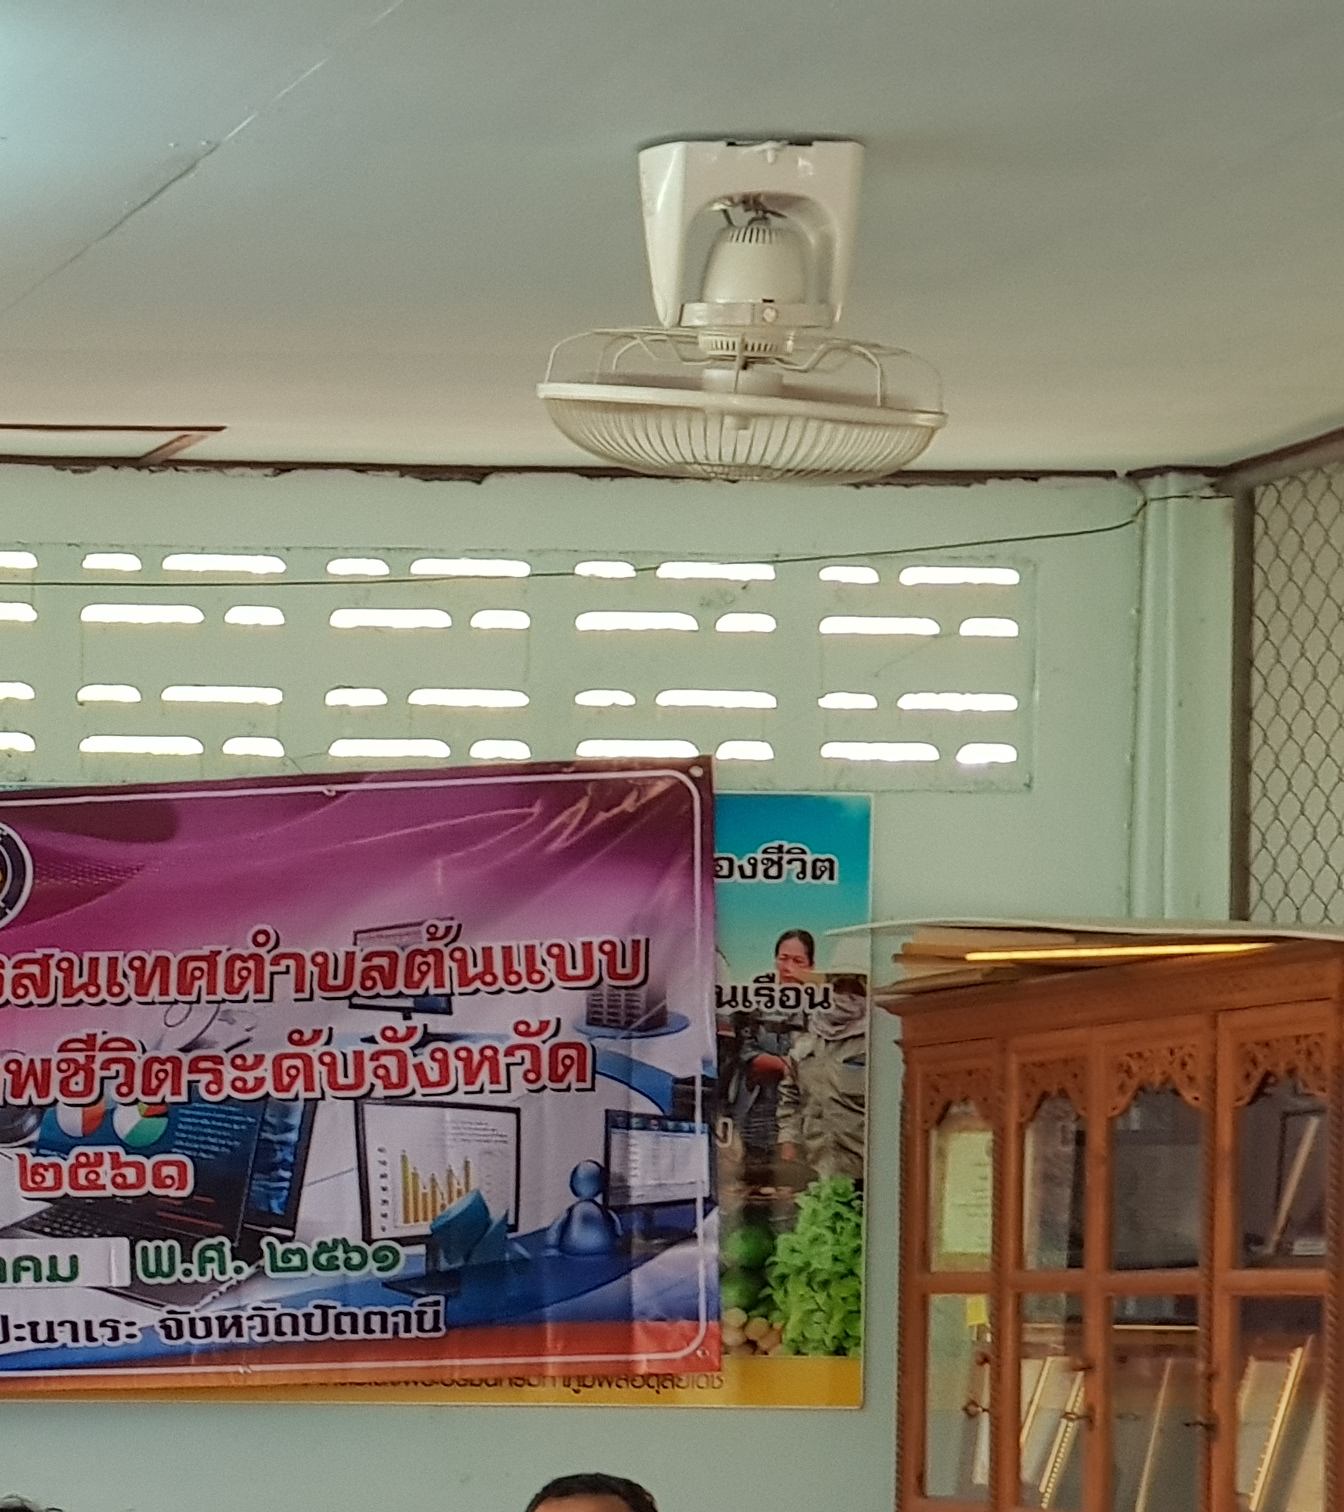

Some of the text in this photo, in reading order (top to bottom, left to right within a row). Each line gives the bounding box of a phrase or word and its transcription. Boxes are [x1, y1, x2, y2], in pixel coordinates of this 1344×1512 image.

[14, 1148, 192, 1195] ๒๕๖๑
[138, 1236, 246, 1284] พ.ศ.
[265, 1236, 403, 1276] ๒๕๖๑
[158, 1300, 445, 1342] จังหวัดปัตตานี
